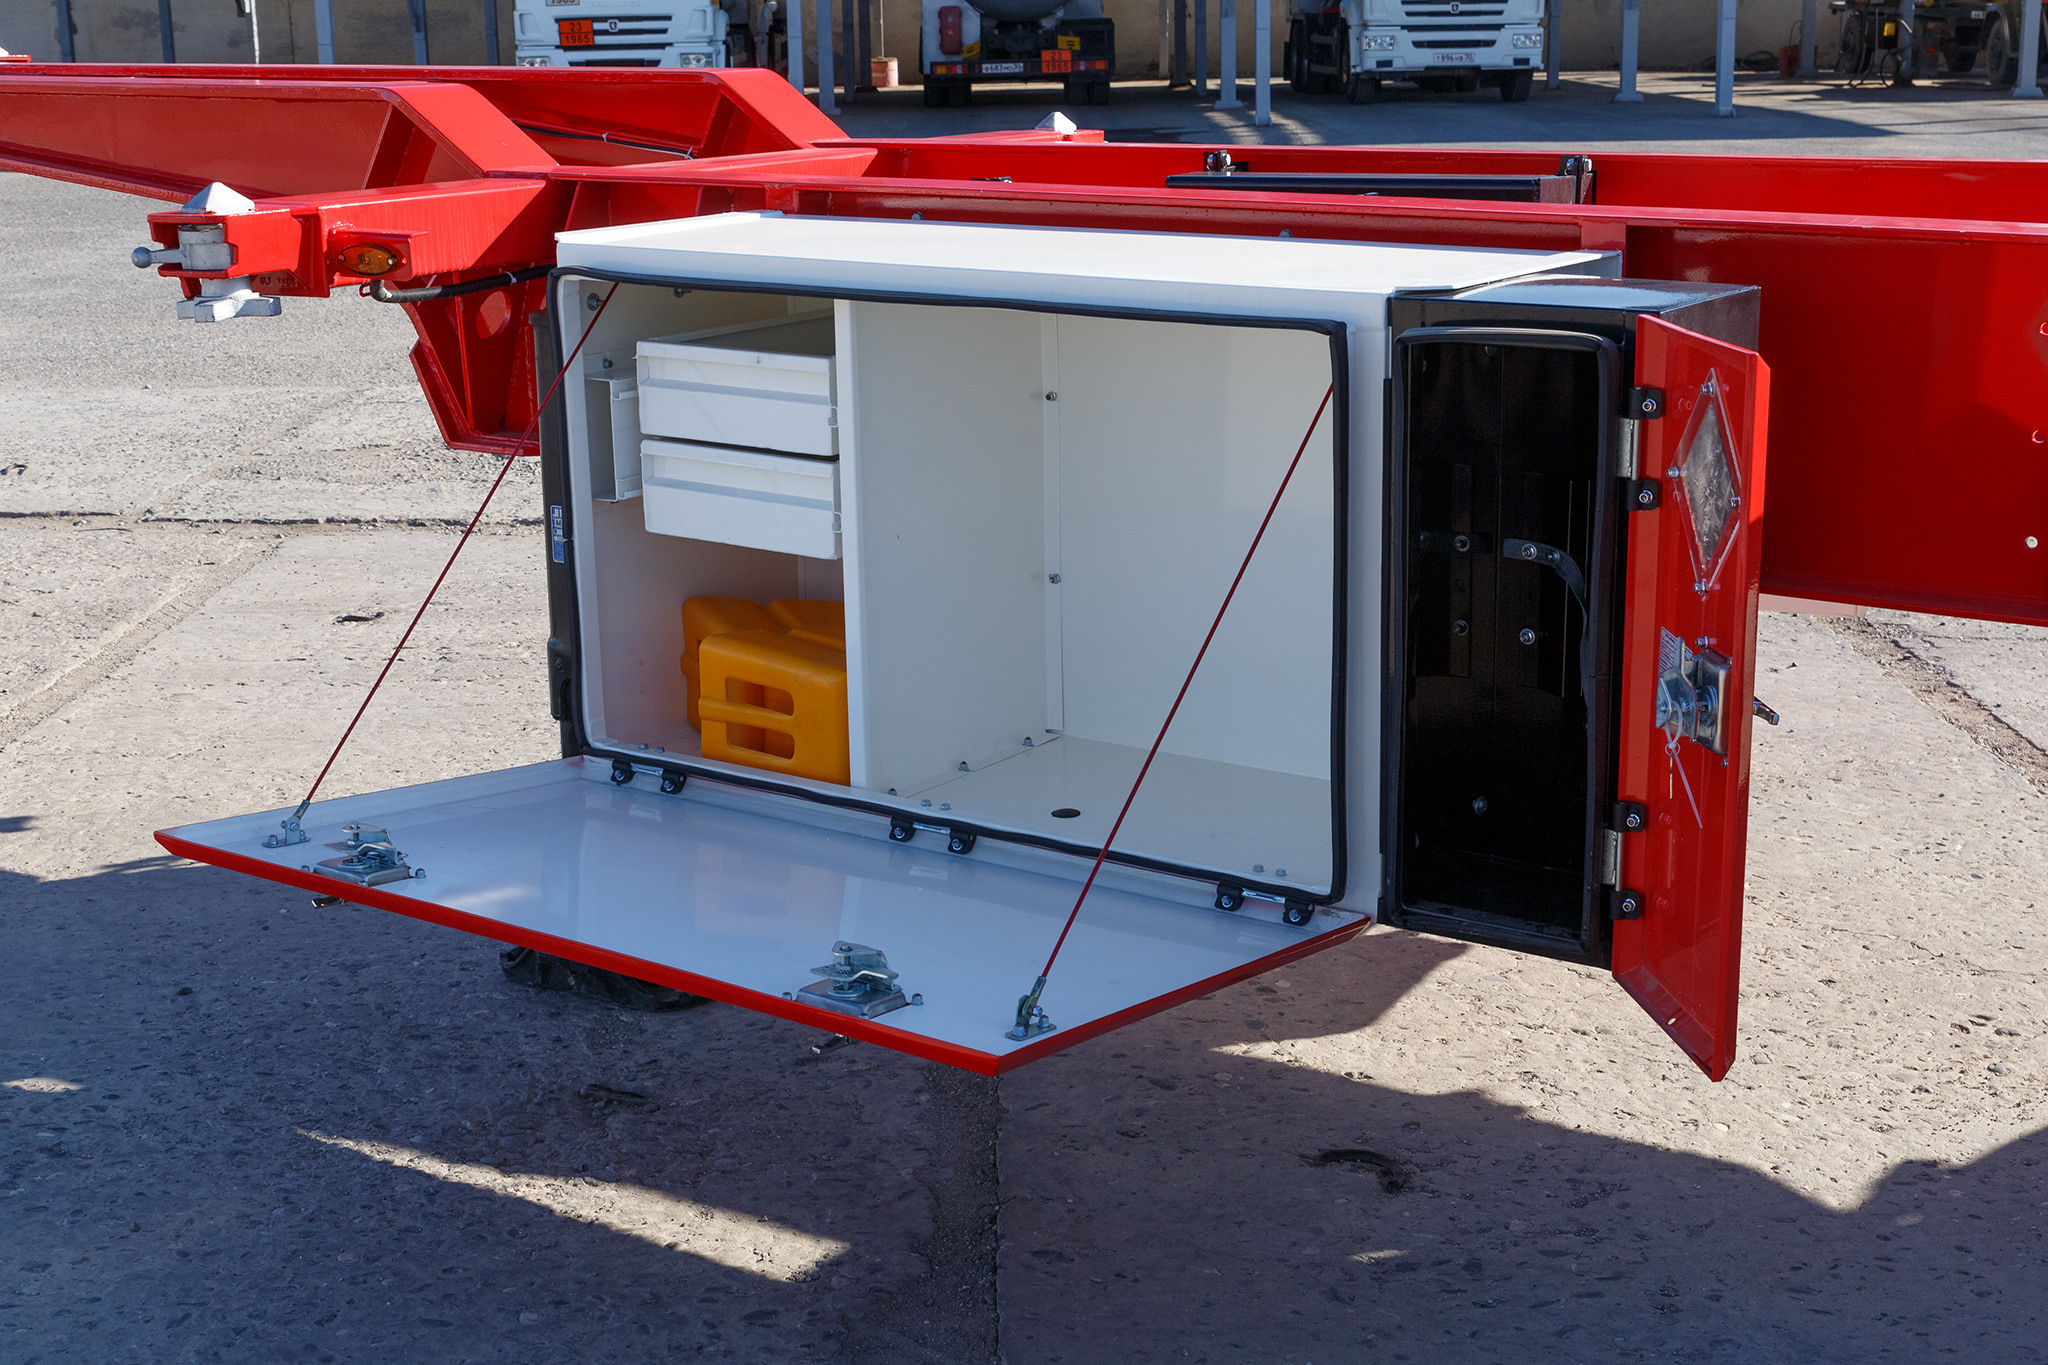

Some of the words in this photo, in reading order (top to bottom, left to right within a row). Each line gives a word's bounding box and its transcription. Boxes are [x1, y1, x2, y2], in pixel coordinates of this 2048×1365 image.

[569, 22, 582, 32] 23
[565, 34, 590, 44] 1965
[1051, 50, 1062, 60] 23
[1046, 61, 1069, 72] 1965
